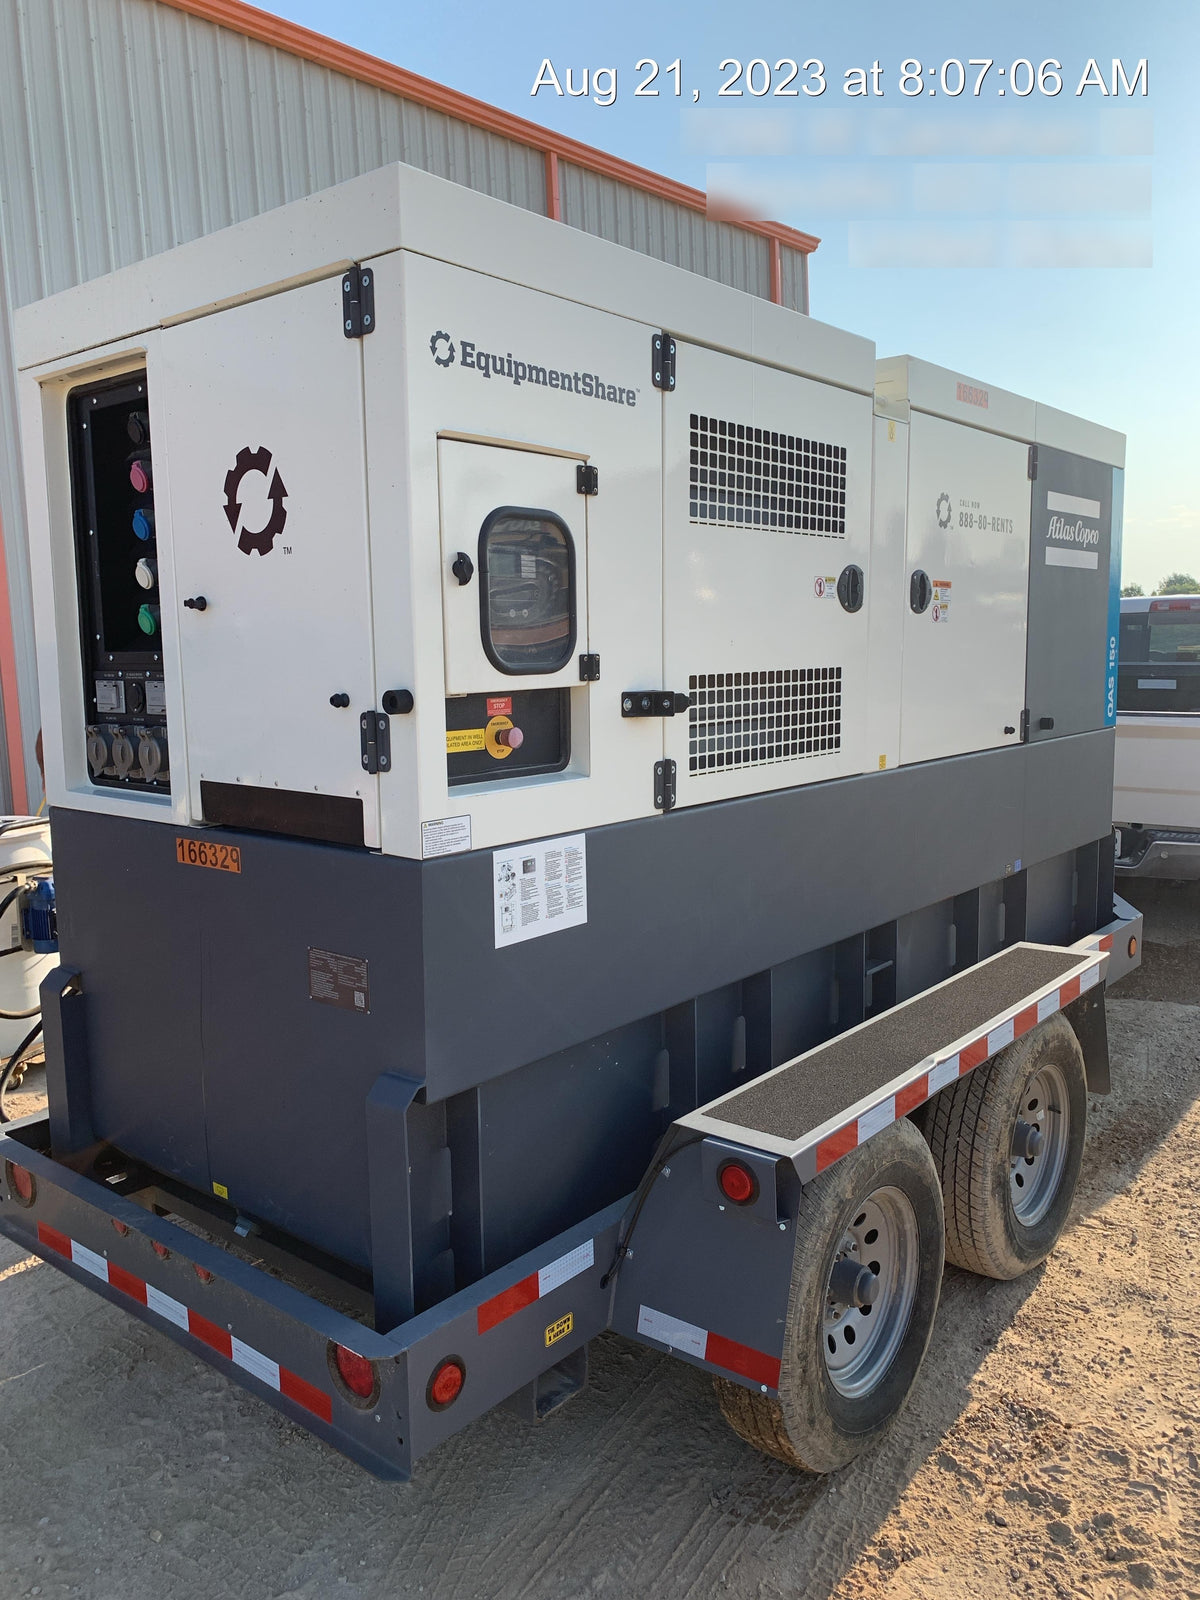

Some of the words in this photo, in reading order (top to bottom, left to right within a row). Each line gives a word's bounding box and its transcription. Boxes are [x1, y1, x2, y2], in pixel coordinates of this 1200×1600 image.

[460, 340, 637, 407] EquipmentShare
[959, 499, 970, 508] CALL
[959, 511, 1013, 534] 888-80-RENTS
[1046, 516, 1075, 542] Atlas
[1074, 520, 1099, 548] Copco
[282, 546, 293, 555] TM
[178, 839, 240, 872] 166329
